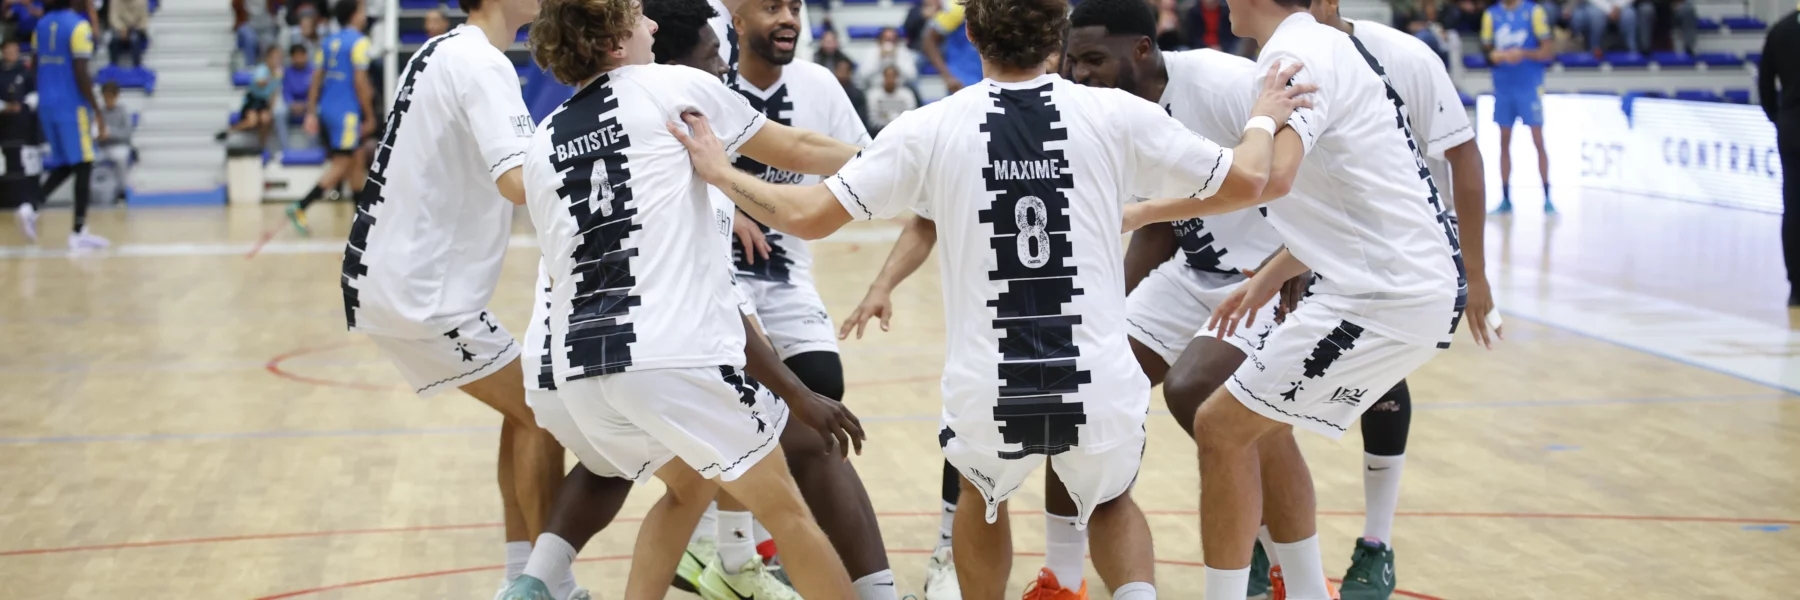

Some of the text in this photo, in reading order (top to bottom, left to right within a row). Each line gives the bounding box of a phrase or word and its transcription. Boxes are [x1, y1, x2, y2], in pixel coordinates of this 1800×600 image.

[555, 124, 620, 162] BATISTE
[588, 157, 615, 217] 4
[757, 165, 805, 185] hon
[993, 159, 1061, 180] MAXIME
[1014, 195, 1051, 269] 8
